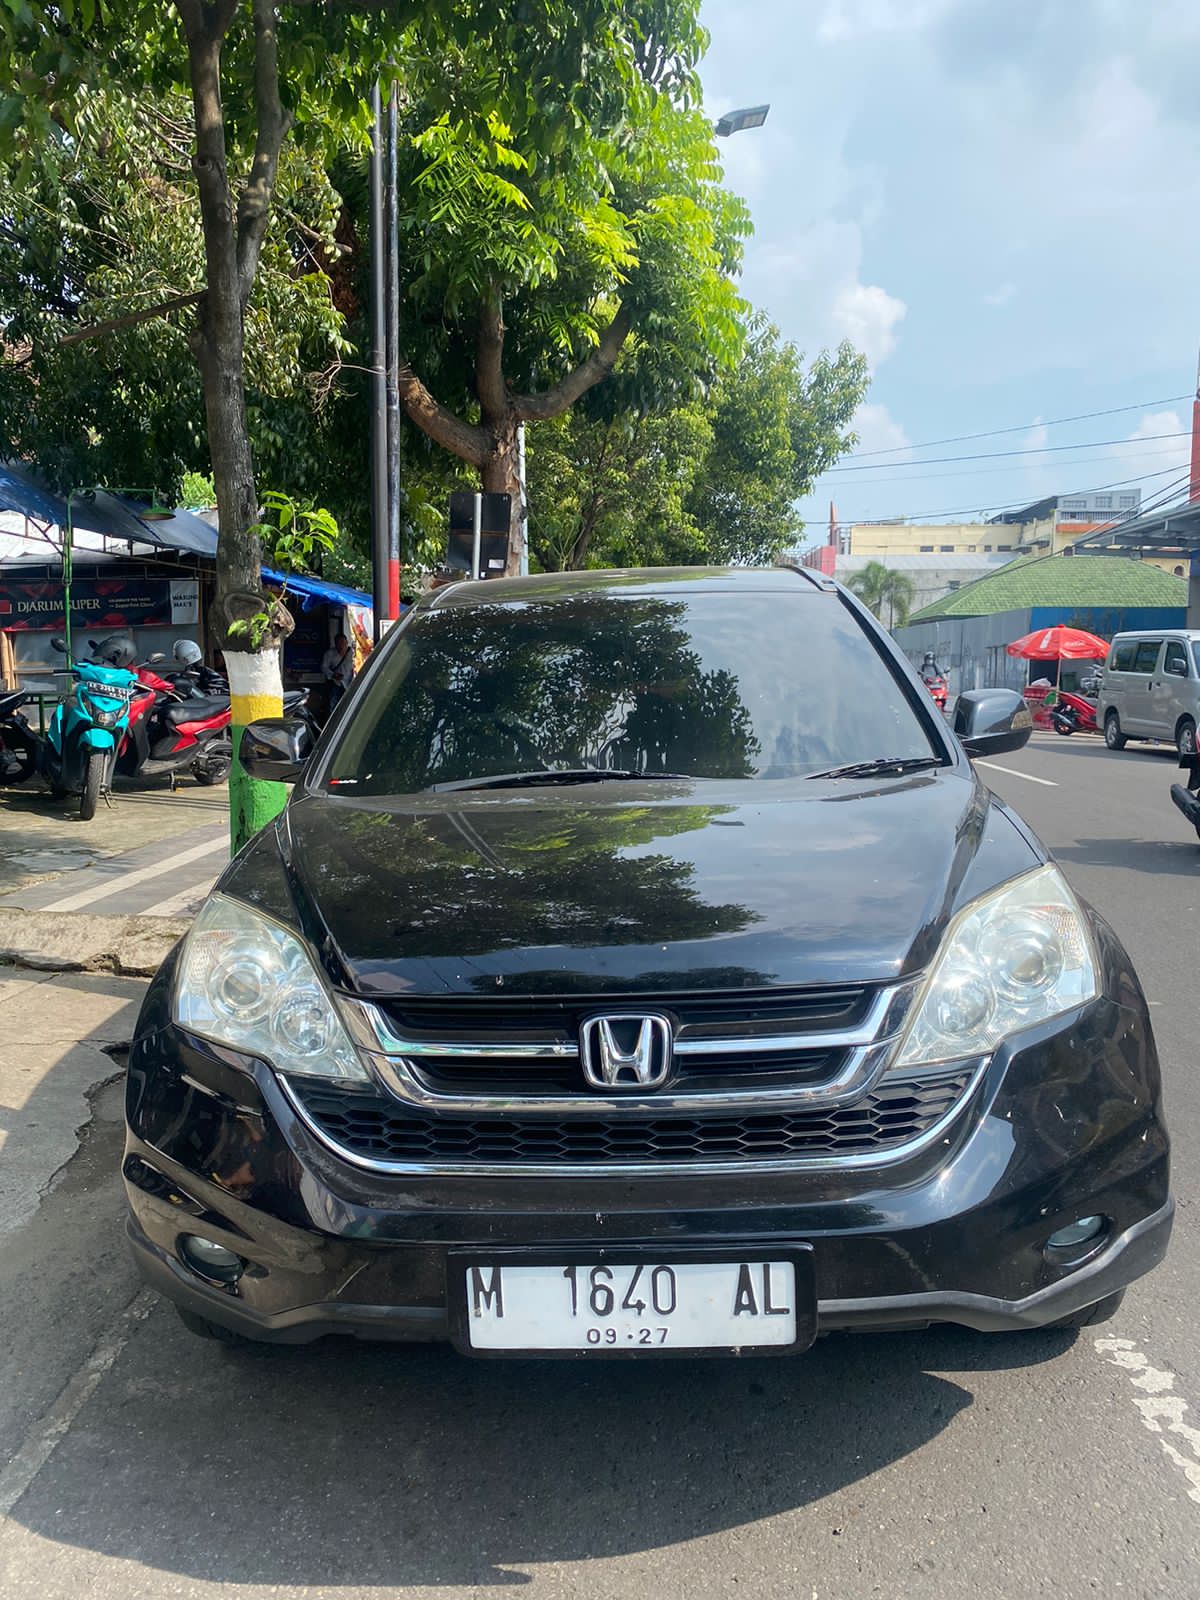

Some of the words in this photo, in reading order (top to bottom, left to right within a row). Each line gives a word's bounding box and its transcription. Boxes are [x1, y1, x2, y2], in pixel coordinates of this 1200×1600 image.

[17, 601, 64, 613] DJARUM
[471, 1266, 504, 1318] M
[563, 1264, 677, 1317] 1640
[733, 1263, 791, 1316] AL
